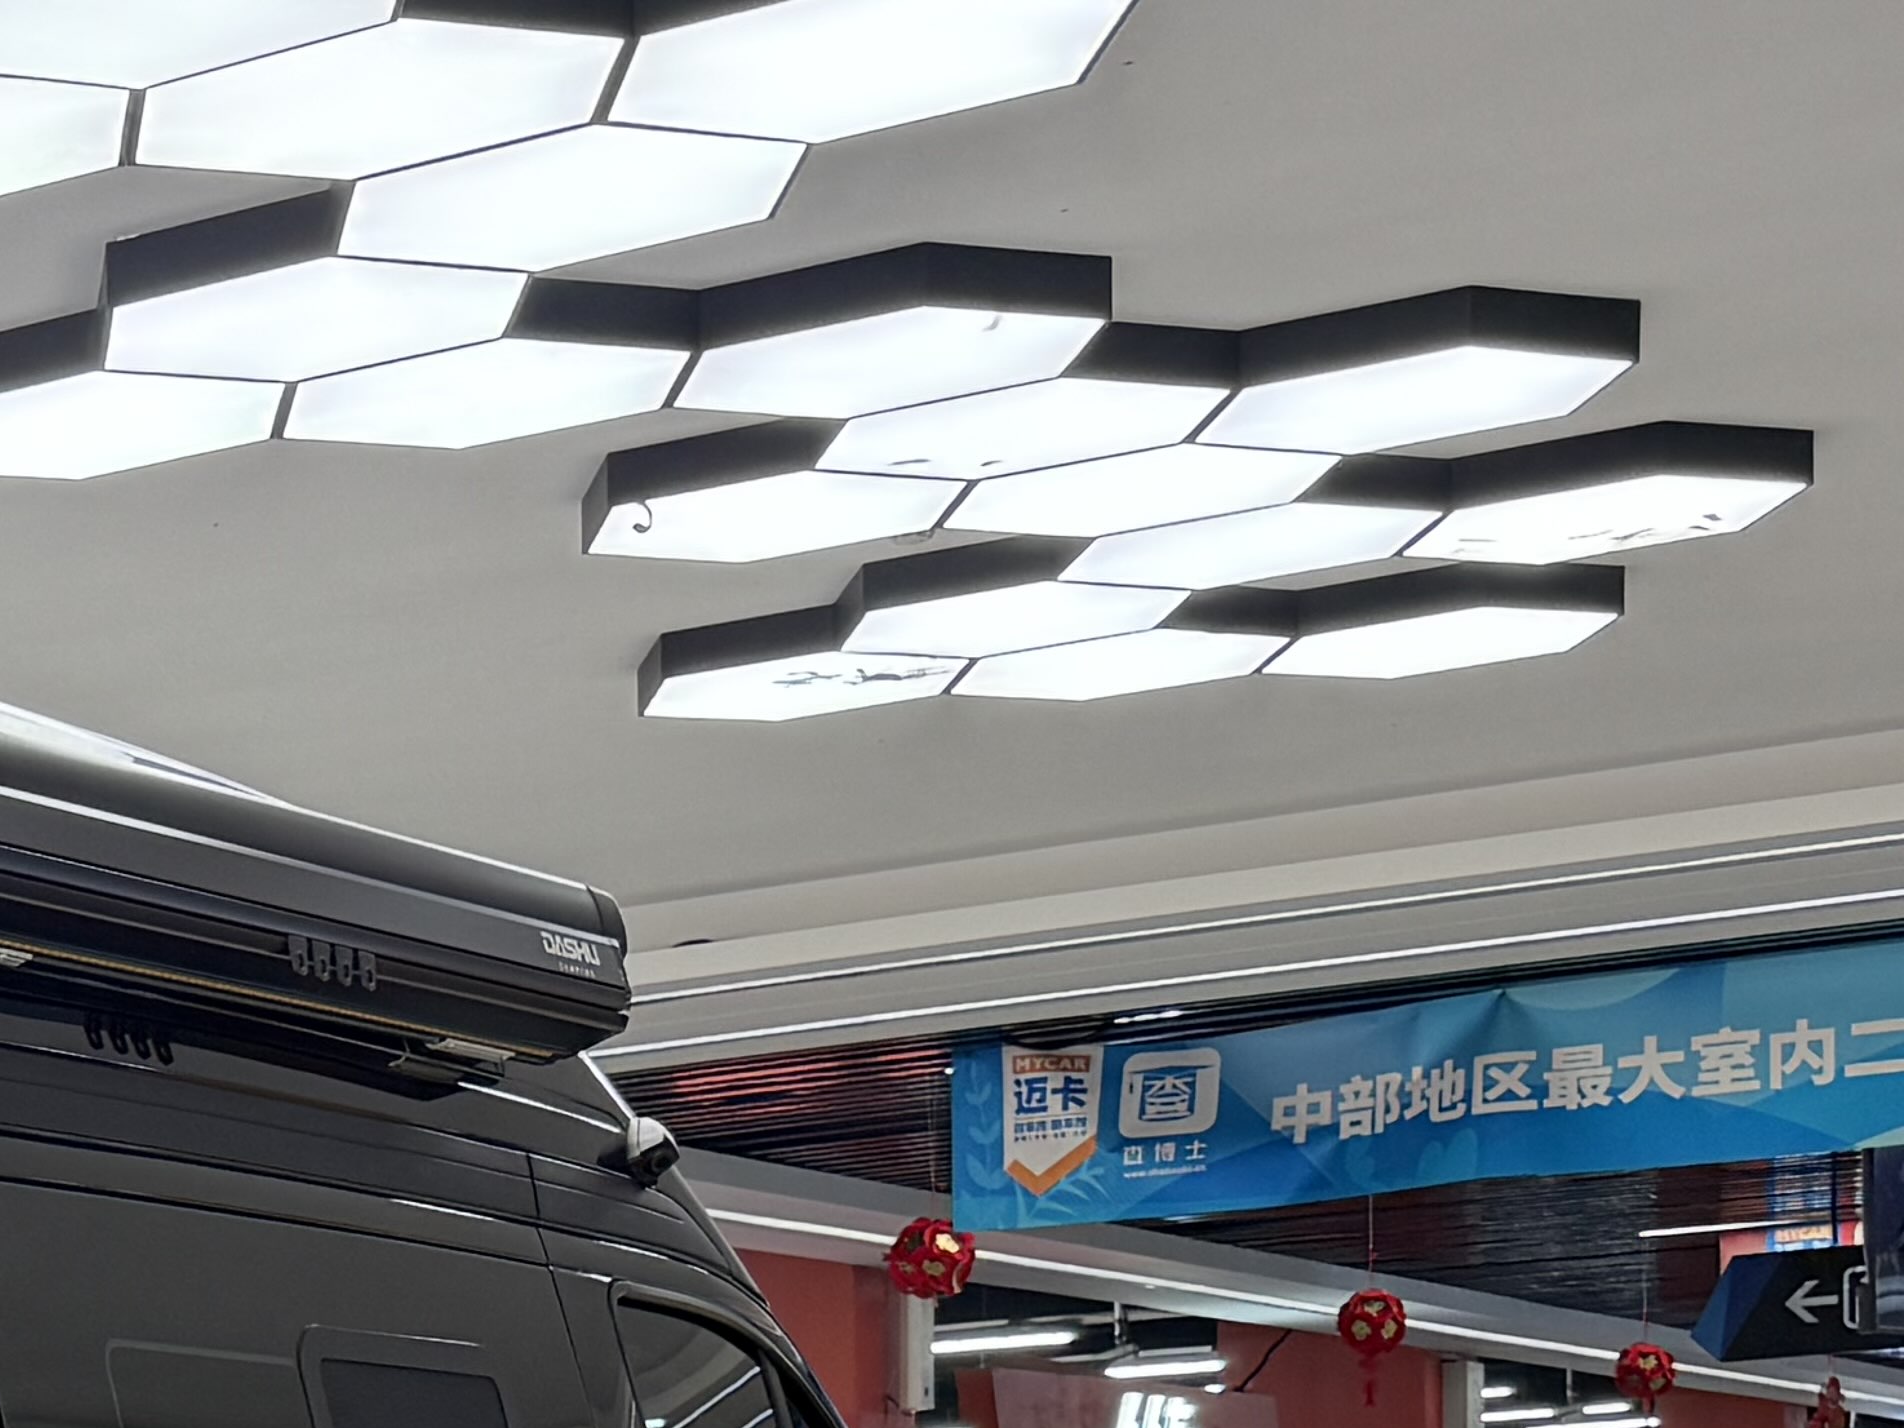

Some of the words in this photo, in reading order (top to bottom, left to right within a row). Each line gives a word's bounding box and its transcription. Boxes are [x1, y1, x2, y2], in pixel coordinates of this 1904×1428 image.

[1014, 1056, 1088, 1072] MYCAR
[1270, 1019, 1904, 1145] 中部地区最大室内二
[1013, 1075, 1089, 1116] 迈卡
